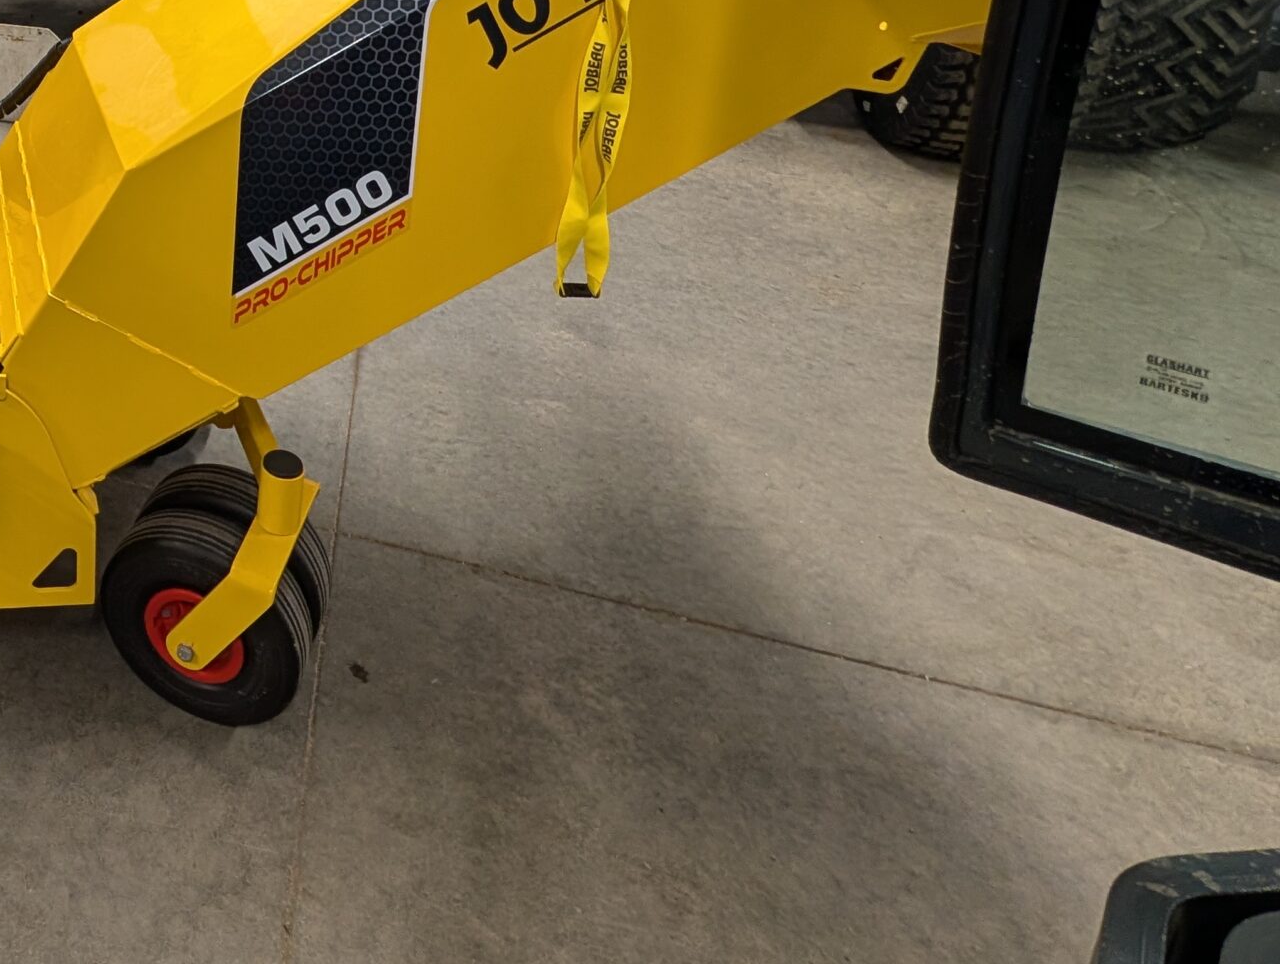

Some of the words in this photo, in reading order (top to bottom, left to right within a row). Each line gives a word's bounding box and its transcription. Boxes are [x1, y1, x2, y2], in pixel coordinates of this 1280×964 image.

[584, 42, 606, 93] JOBEAU
[611, 43, 628, 94] JOBEAU
[602, 111, 621, 164] JOBEAU
[246, 169, 393, 273] M500
[233, 208, 407, 324] PRO-CHIPPER
